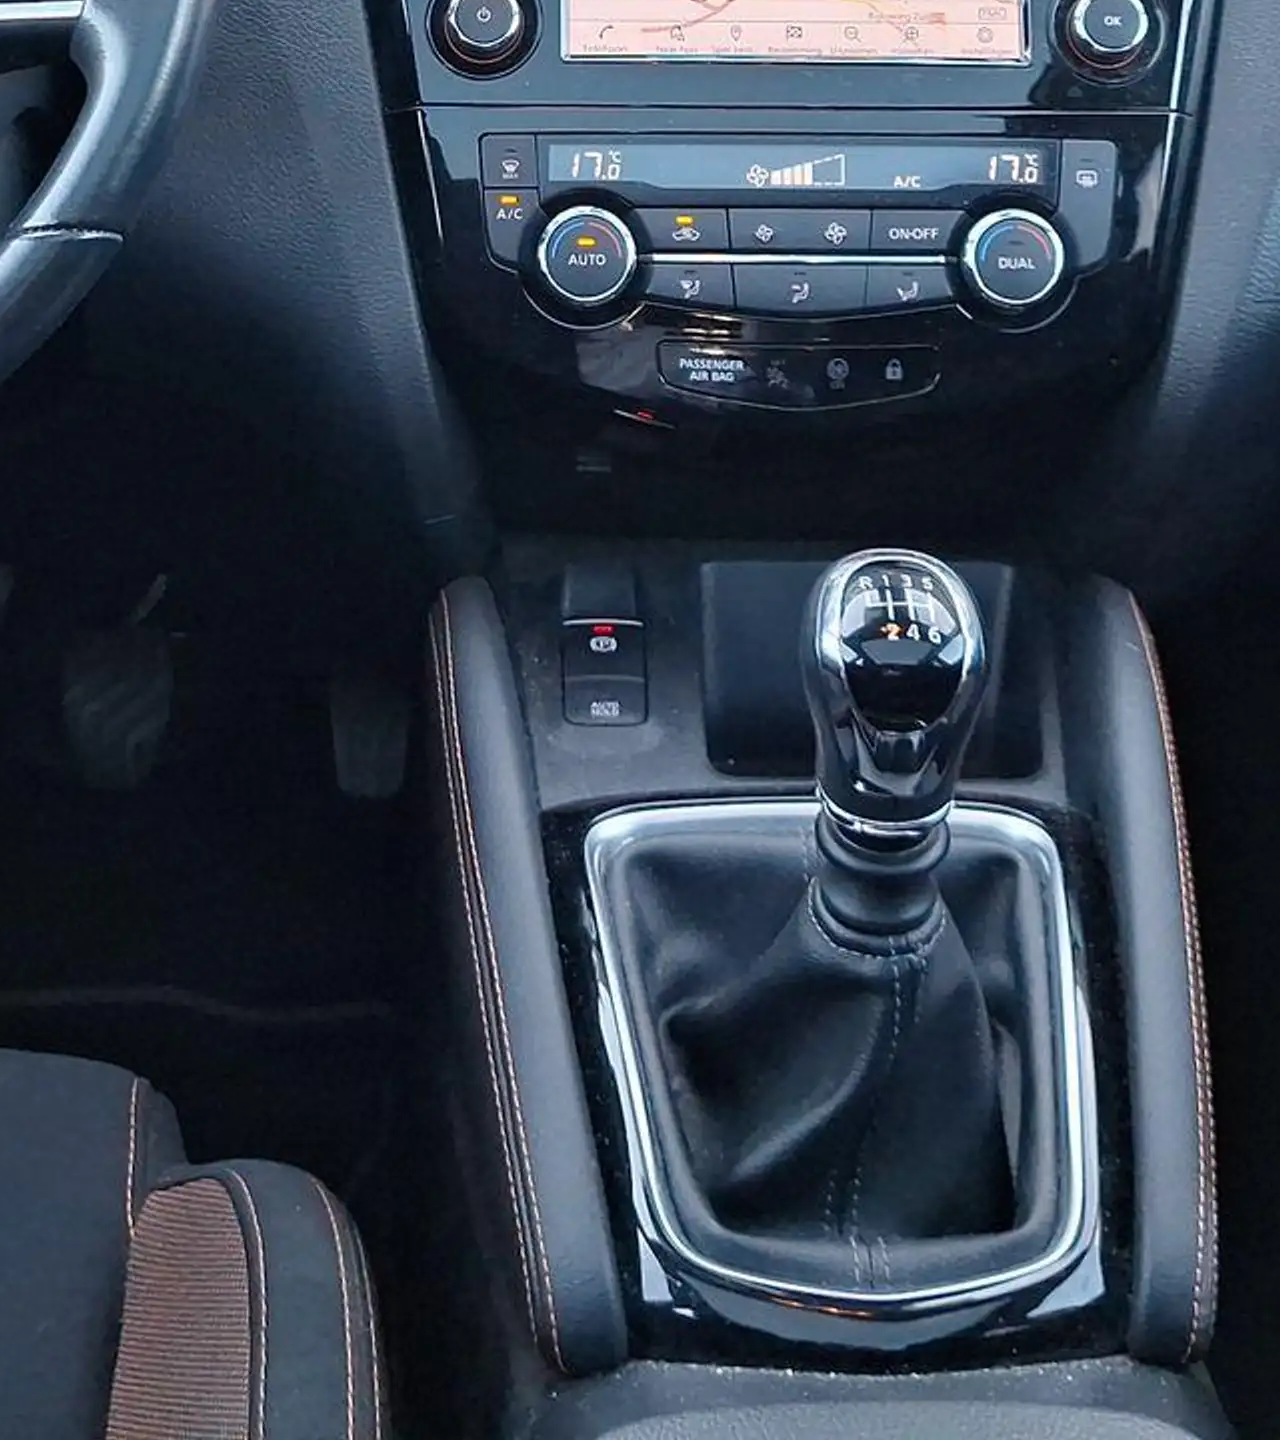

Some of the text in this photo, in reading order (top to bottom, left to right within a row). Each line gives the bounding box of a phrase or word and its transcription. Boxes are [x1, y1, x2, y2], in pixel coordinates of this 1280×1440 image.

[1103, 15, 1122, 27] OK
[893, 175, 921, 188] A/C
[496, 208, 523, 220] A/C
[568, 254, 606, 266] AUTO
[998, 257, 1036, 270] DUAL
[679, 359, 745, 370] PASSENGER
[690, 371, 735, 381] AIR BAG
[882, 574, 891, 587] 1
[900, 574, 913, 587] 3
[921, 577, 933, 590] 5
[906, 624, 920, 641] 4
[928, 626, 941, 644] 6
